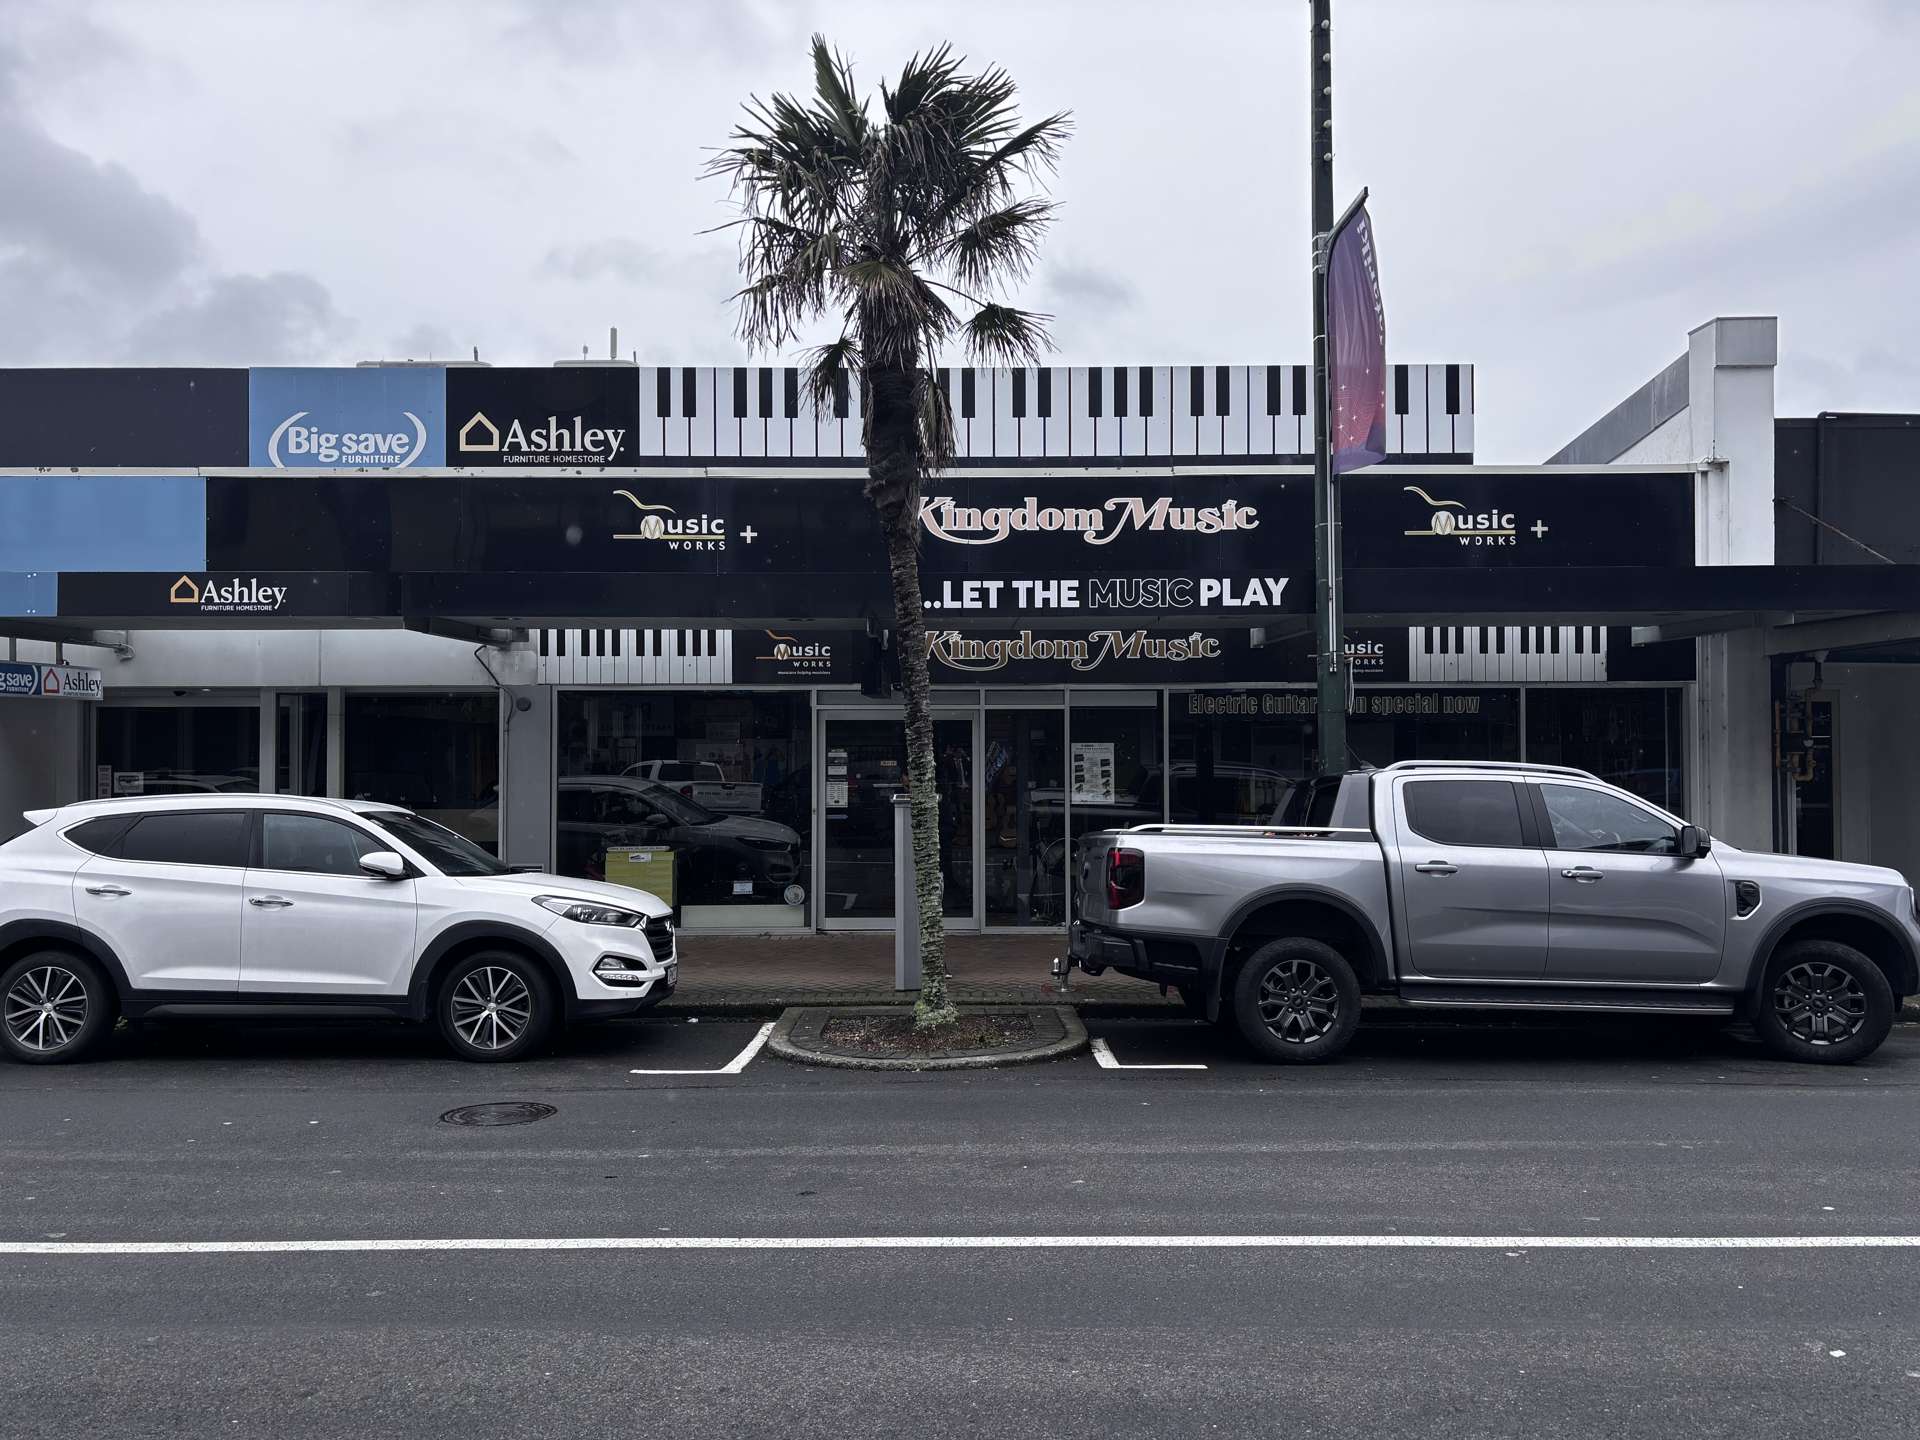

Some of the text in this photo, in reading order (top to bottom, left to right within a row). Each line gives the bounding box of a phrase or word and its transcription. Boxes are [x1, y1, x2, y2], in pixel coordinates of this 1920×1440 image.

[288, 427, 410, 463] Big save
[342, 455, 401, 464] FURNITURE
[503, 455, 606, 463] FURNITURE HOMESTORE
[640, 513, 726, 540] Music
[918, 496, 1260, 545] Kingdom Music
[1431, 509, 1516, 536] Music
[667, 541, 726, 551] WORKS
[1459, 536, 1517, 546] WORKS
[1012, 580, 1080, 609] THE
[1089, 578, 1194, 609] MUSIC
[1200, 577, 1290, 608] PLAY
[774, 643, 831, 660] Music
[925, 630, 1222, 672] Kingdom Music
[1344, 640, 1384, 654] usic
[6, 672, 33, 687] save
[1188, 693, 1259, 715] Electric
[1371, 692, 1439, 716] special
[1443, 695, 1480, 714] now
